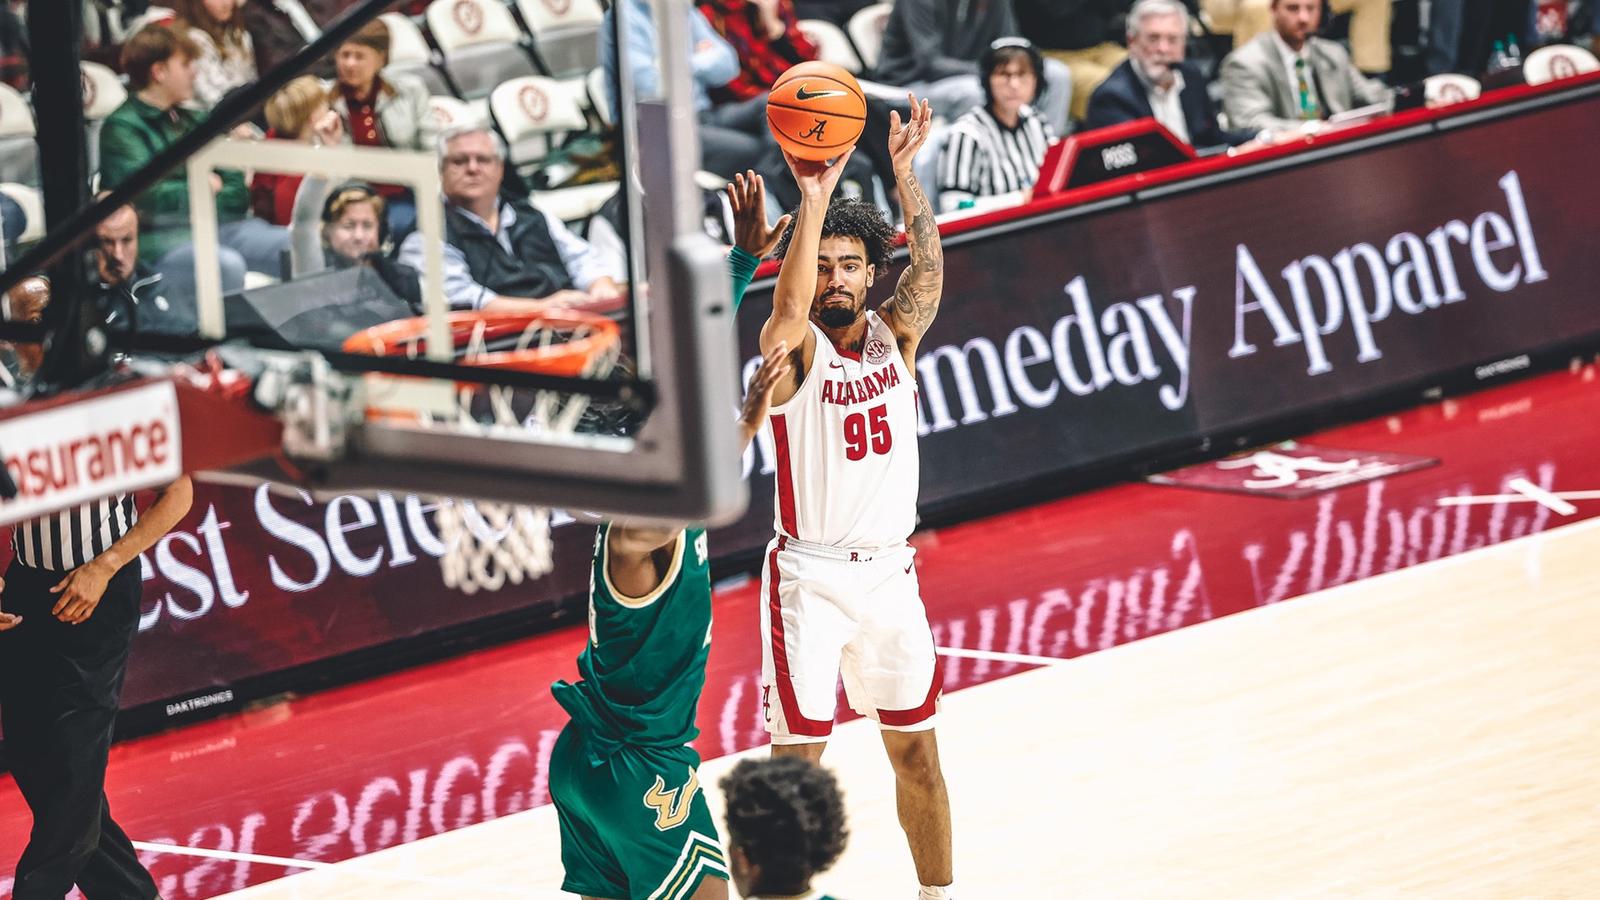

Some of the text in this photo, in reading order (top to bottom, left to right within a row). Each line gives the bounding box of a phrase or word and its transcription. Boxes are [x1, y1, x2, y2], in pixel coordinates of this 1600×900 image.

[916, 276, 1198, 437] meday
[1228, 170, 1549, 377] Apparel
[822, 362, 901, 406] ALABAMA
[6, 419, 168, 497] nsurance
[843, 403, 893, 461] 95
